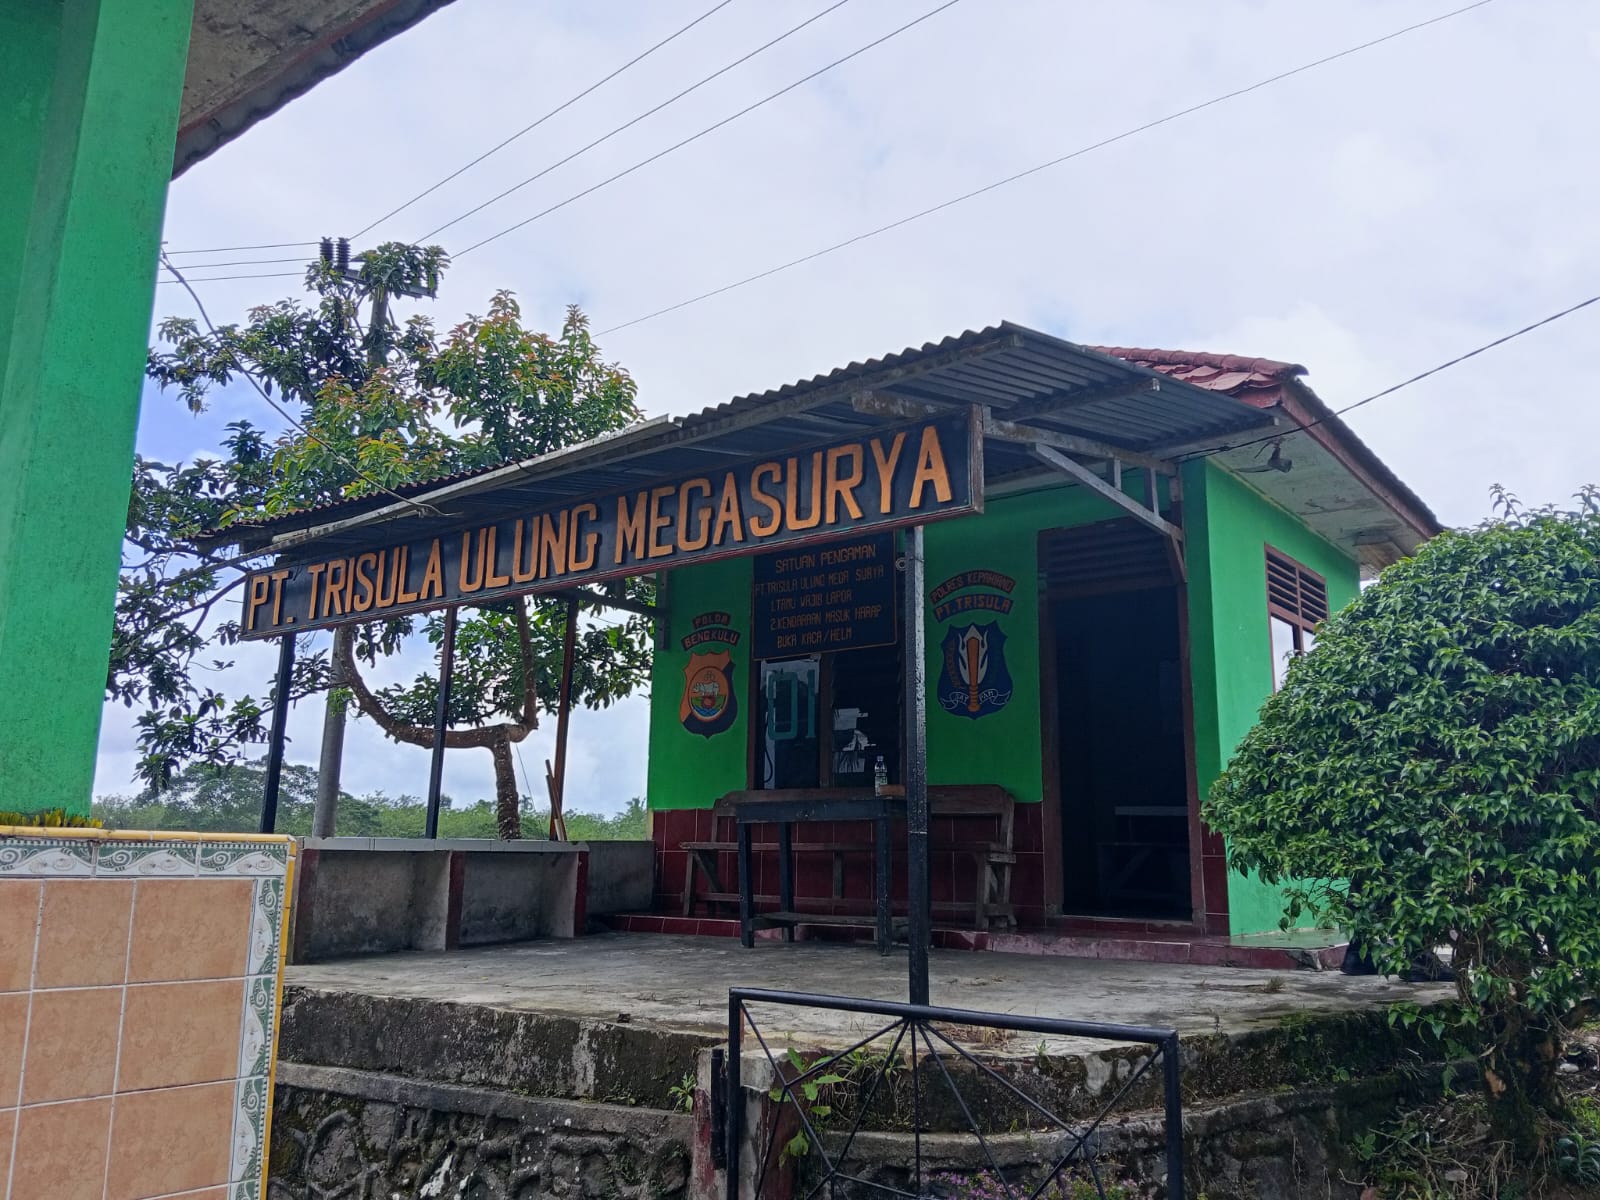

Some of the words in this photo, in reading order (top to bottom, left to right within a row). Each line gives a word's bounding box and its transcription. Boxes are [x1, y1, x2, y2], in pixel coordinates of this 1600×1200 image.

[248, 570, 294, 630] PT.
[307, 538, 443, 620] TRISULA
[459, 503, 598, 593] ULUNG
[775, 554, 815, 574] SATUAN
[820, 543, 876, 567] PENGAMAN
[855, 564, 884, 581] SURYA
[826, 589, 852, 605] LAPOR
[931, 575, 964, 603] POLRES
[694, 613, 729, 628] POLDA
[825, 608, 850, 623] MASUK
[855, 604, 882, 620] HARAP
[684, 629, 739, 648] BENGKULU
[777, 633, 797, 648] BUKA
